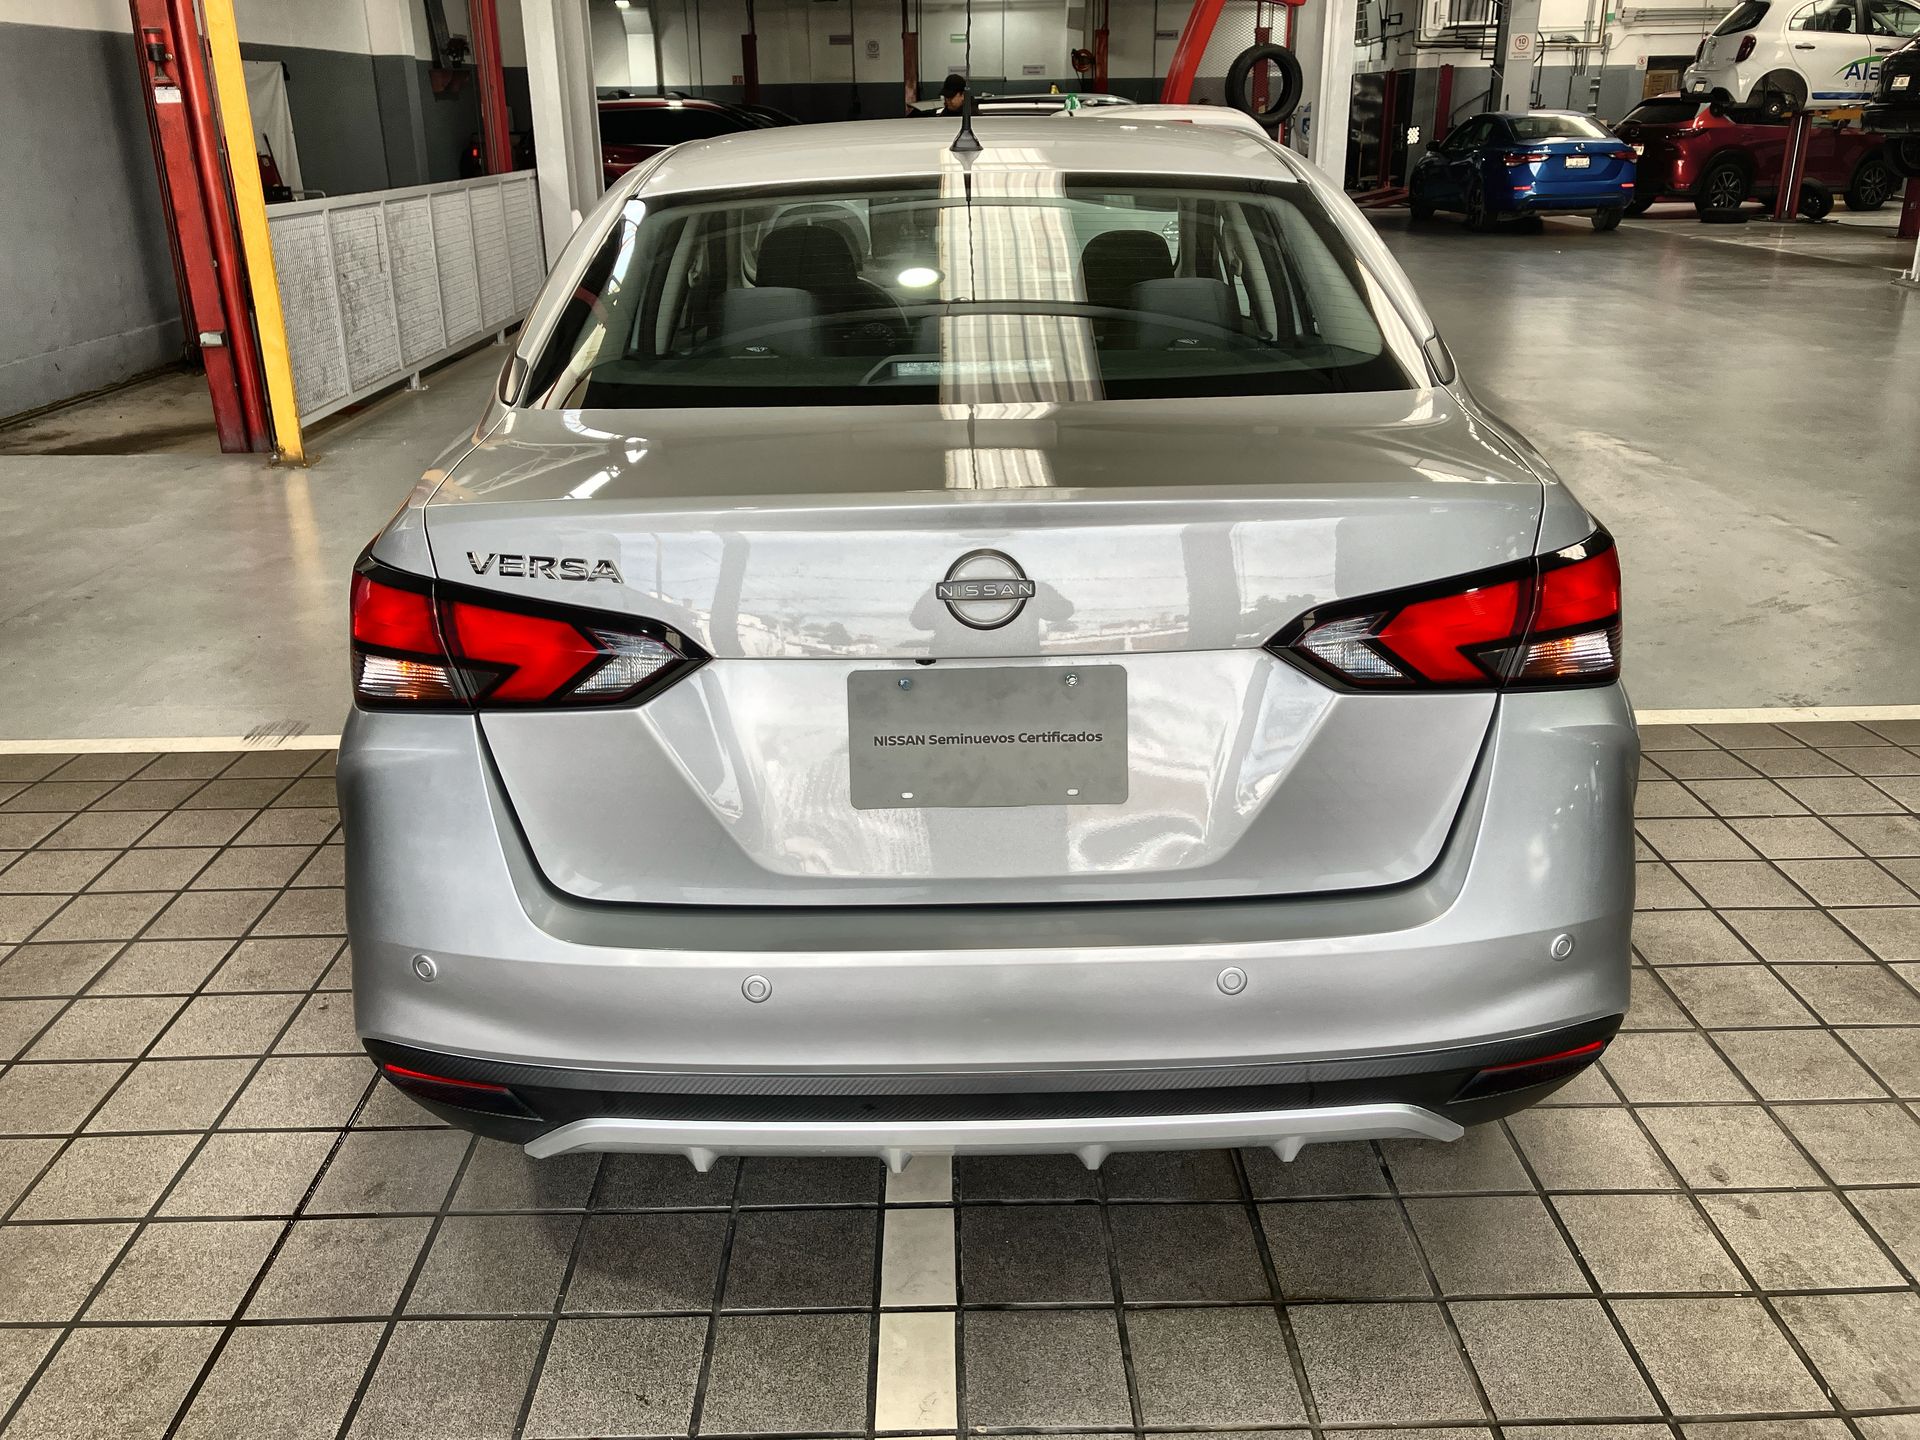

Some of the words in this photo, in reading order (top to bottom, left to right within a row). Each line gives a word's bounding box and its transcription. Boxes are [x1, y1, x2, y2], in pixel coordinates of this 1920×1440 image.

[466, 551, 625, 584] VERSA
[938, 583, 1033, 597] NISSAN
[873, 735, 926, 747] NISSAN
[928, 733, 1015, 745] Seminuevos
[1017, 731, 1103, 744] Certificados
